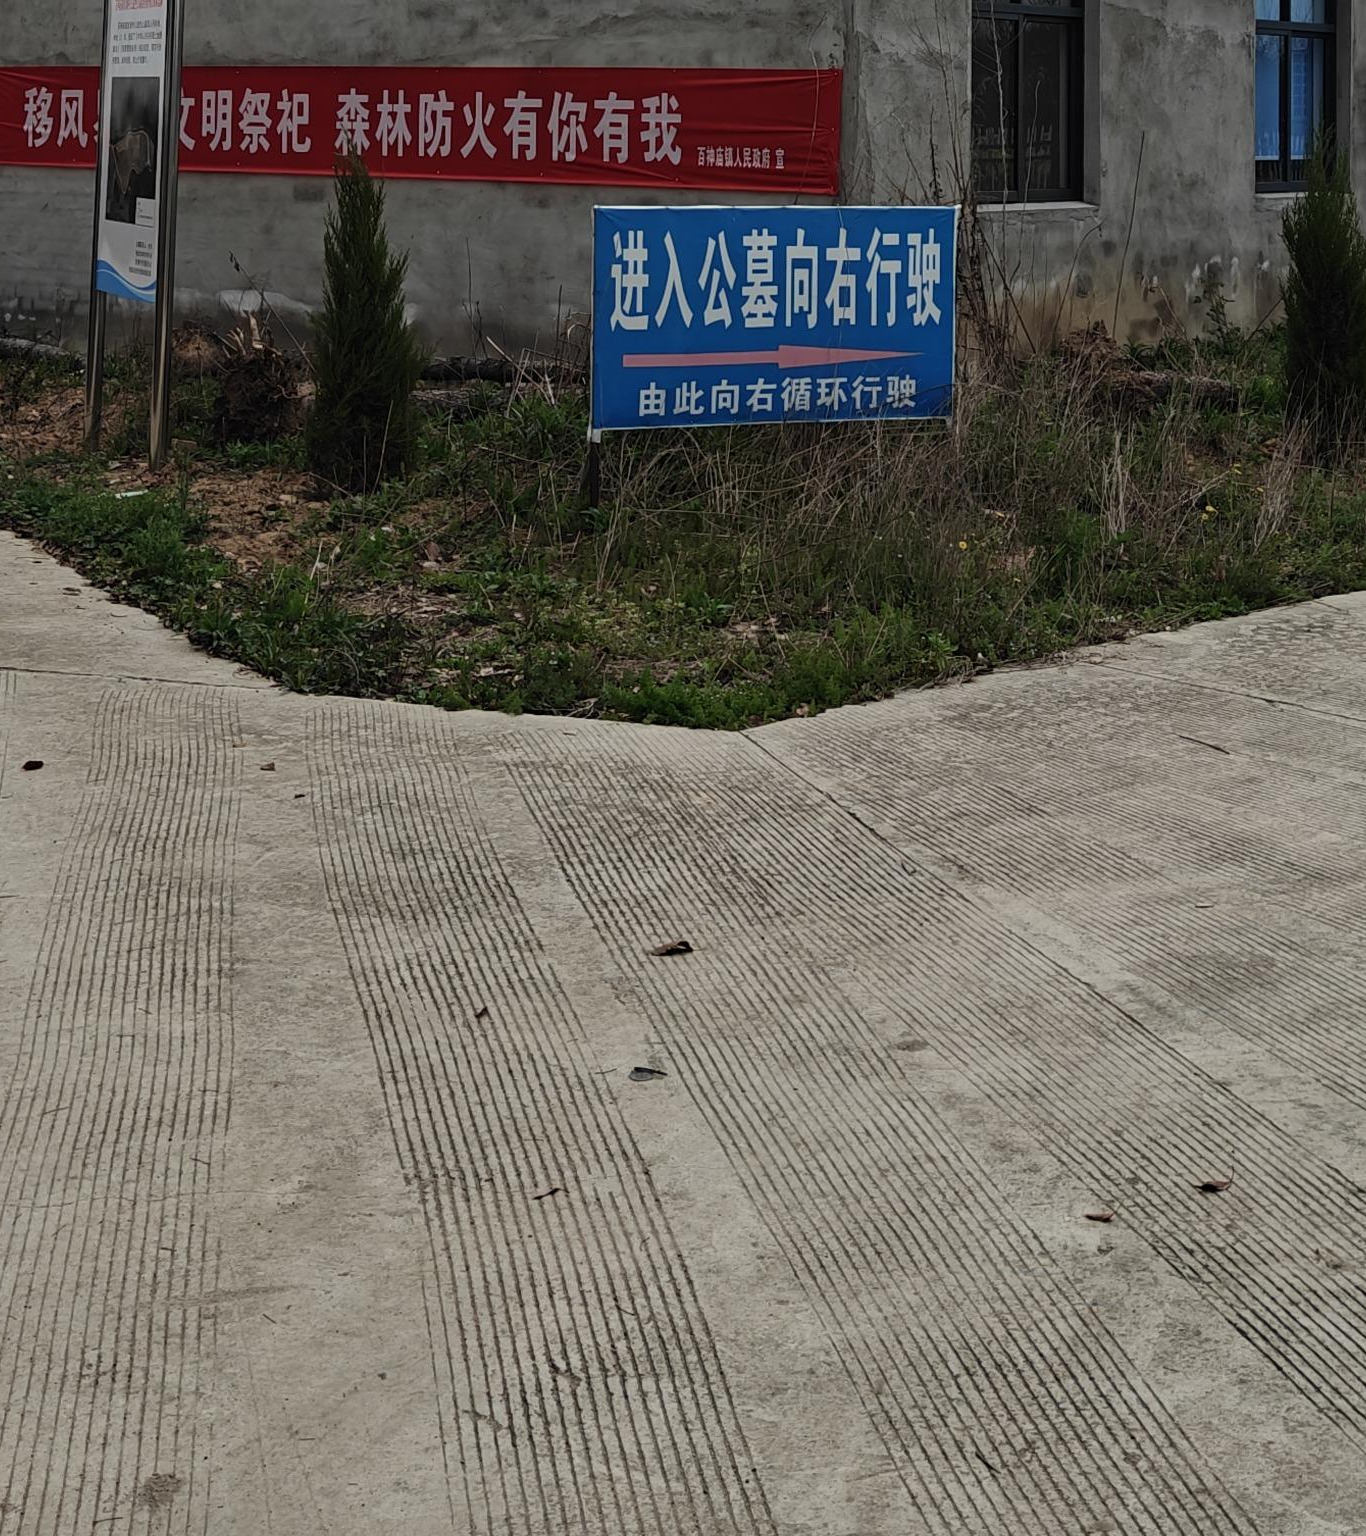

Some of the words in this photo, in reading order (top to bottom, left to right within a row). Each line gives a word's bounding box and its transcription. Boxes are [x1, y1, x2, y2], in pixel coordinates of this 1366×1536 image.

[334, 88, 682, 166] 森林防火有你有我
[697, 145, 771, 169] 百神庙镇人民政府
[775, 147, 785, 169] 宣
[610, 227, 942, 332] 进入公墓向右行驶
[638, 374, 917, 418] 由此向右循环行驶
